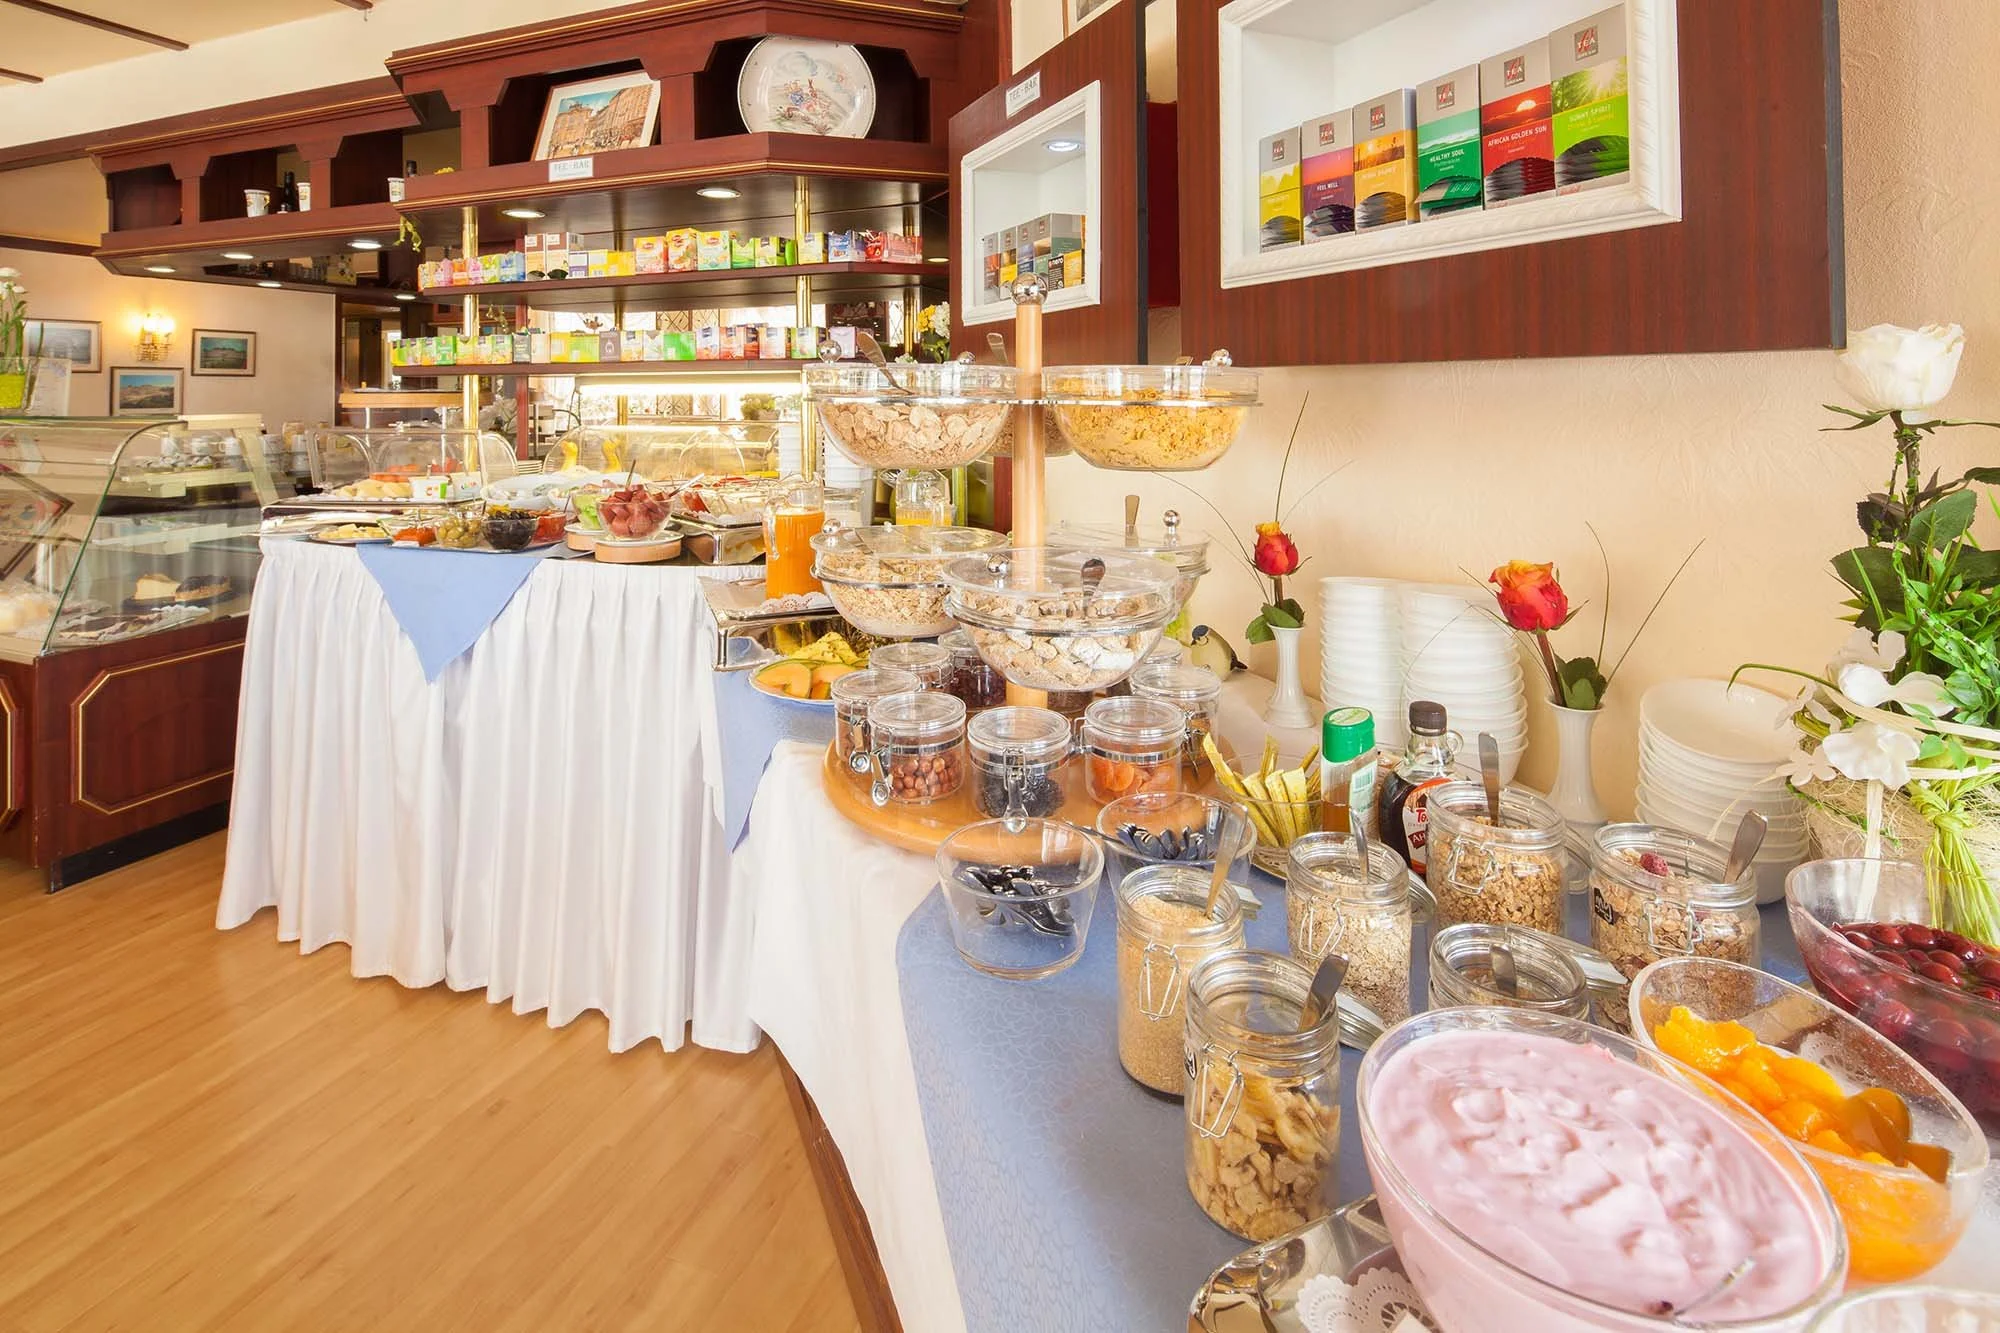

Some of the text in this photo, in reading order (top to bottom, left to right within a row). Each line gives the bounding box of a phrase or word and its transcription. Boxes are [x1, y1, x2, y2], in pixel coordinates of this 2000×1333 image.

[1577, 37, 1596, 49] TEA
[1506, 66, 1523, 77] TEA
[1438, 90, 1453, 99] TEA
[1488, 125, 1547, 147] AFRICAN GOLDEN SUN
[1429, 152, 1451, 163] HEALTHY
[1451, 149, 1465, 157] SOUL
[1415, 808, 1428, 823] To
